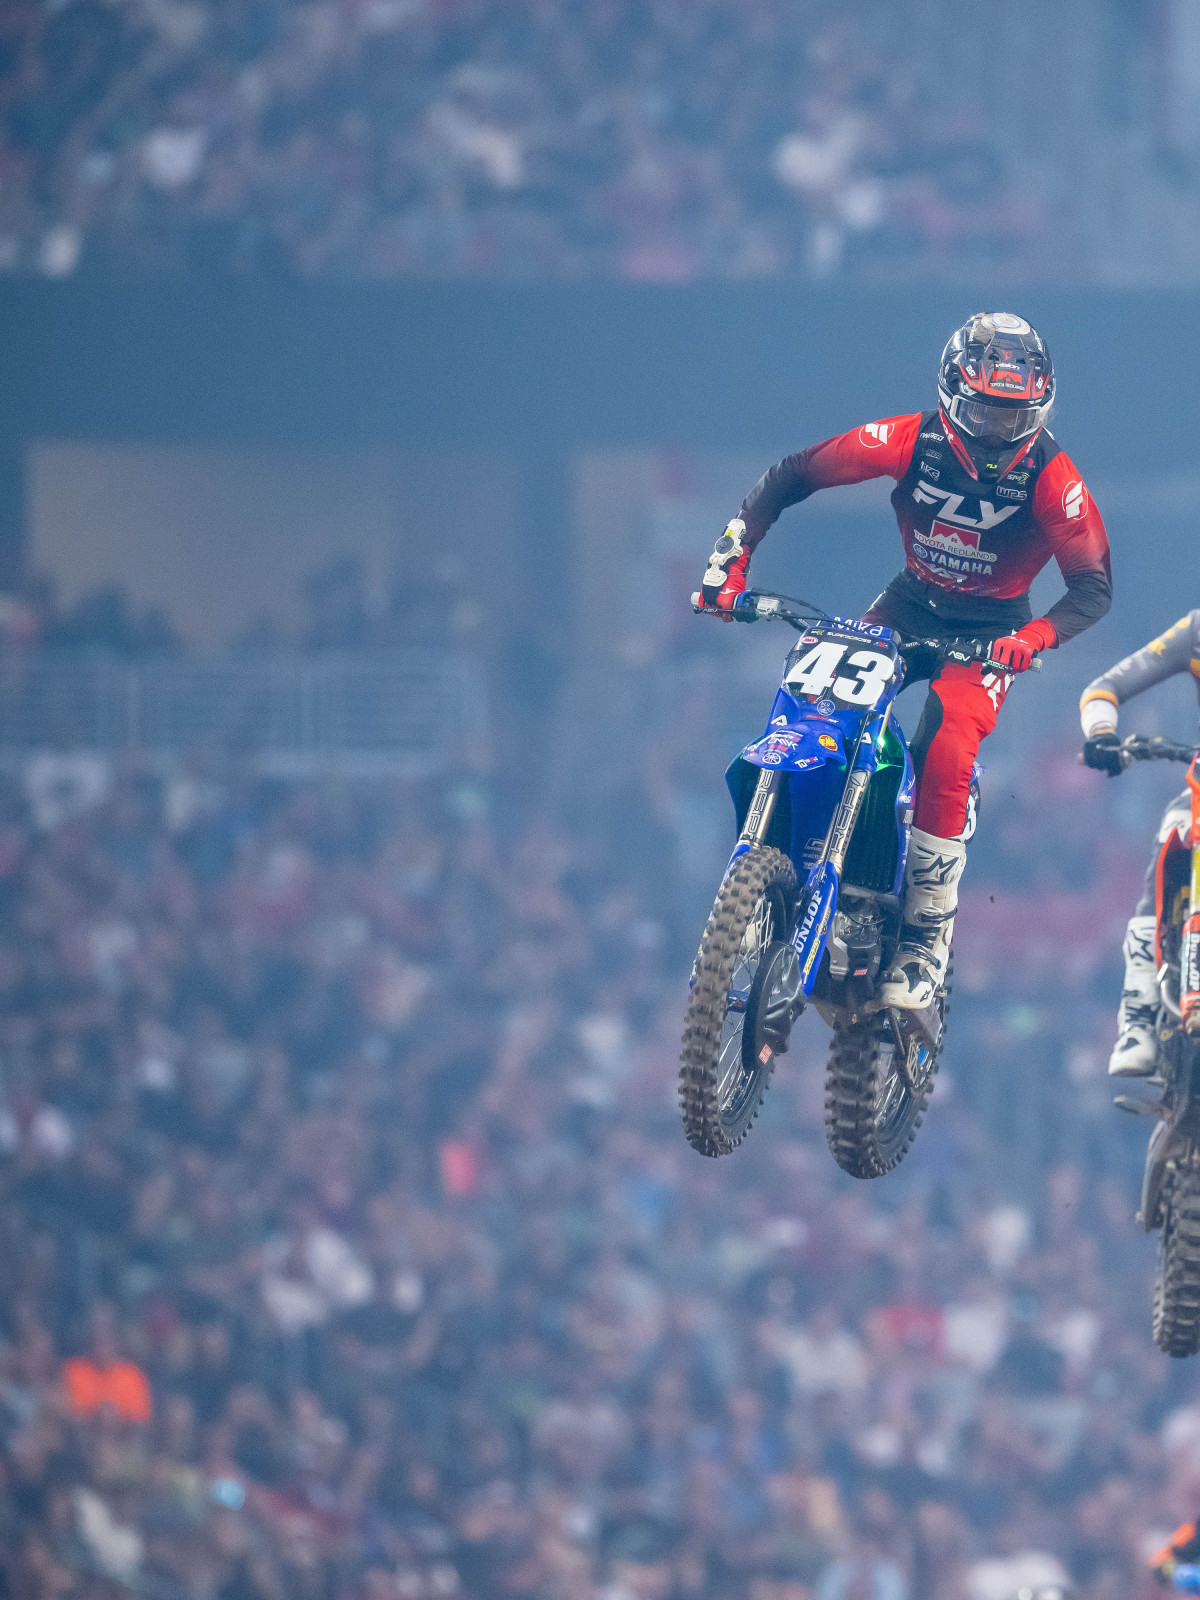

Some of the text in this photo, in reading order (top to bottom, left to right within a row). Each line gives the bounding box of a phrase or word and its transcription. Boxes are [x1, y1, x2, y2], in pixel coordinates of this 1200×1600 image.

[911, 479, 1021, 531] FLY
[914, 531, 997, 562] TOYOTA REDLANDS
[929, 550, 993, 576] YAMAHA
[784, 641, 895, 706] 43
[947, 650, 971, 662] ASV
[795, 889, 823, 956] UNLOP
